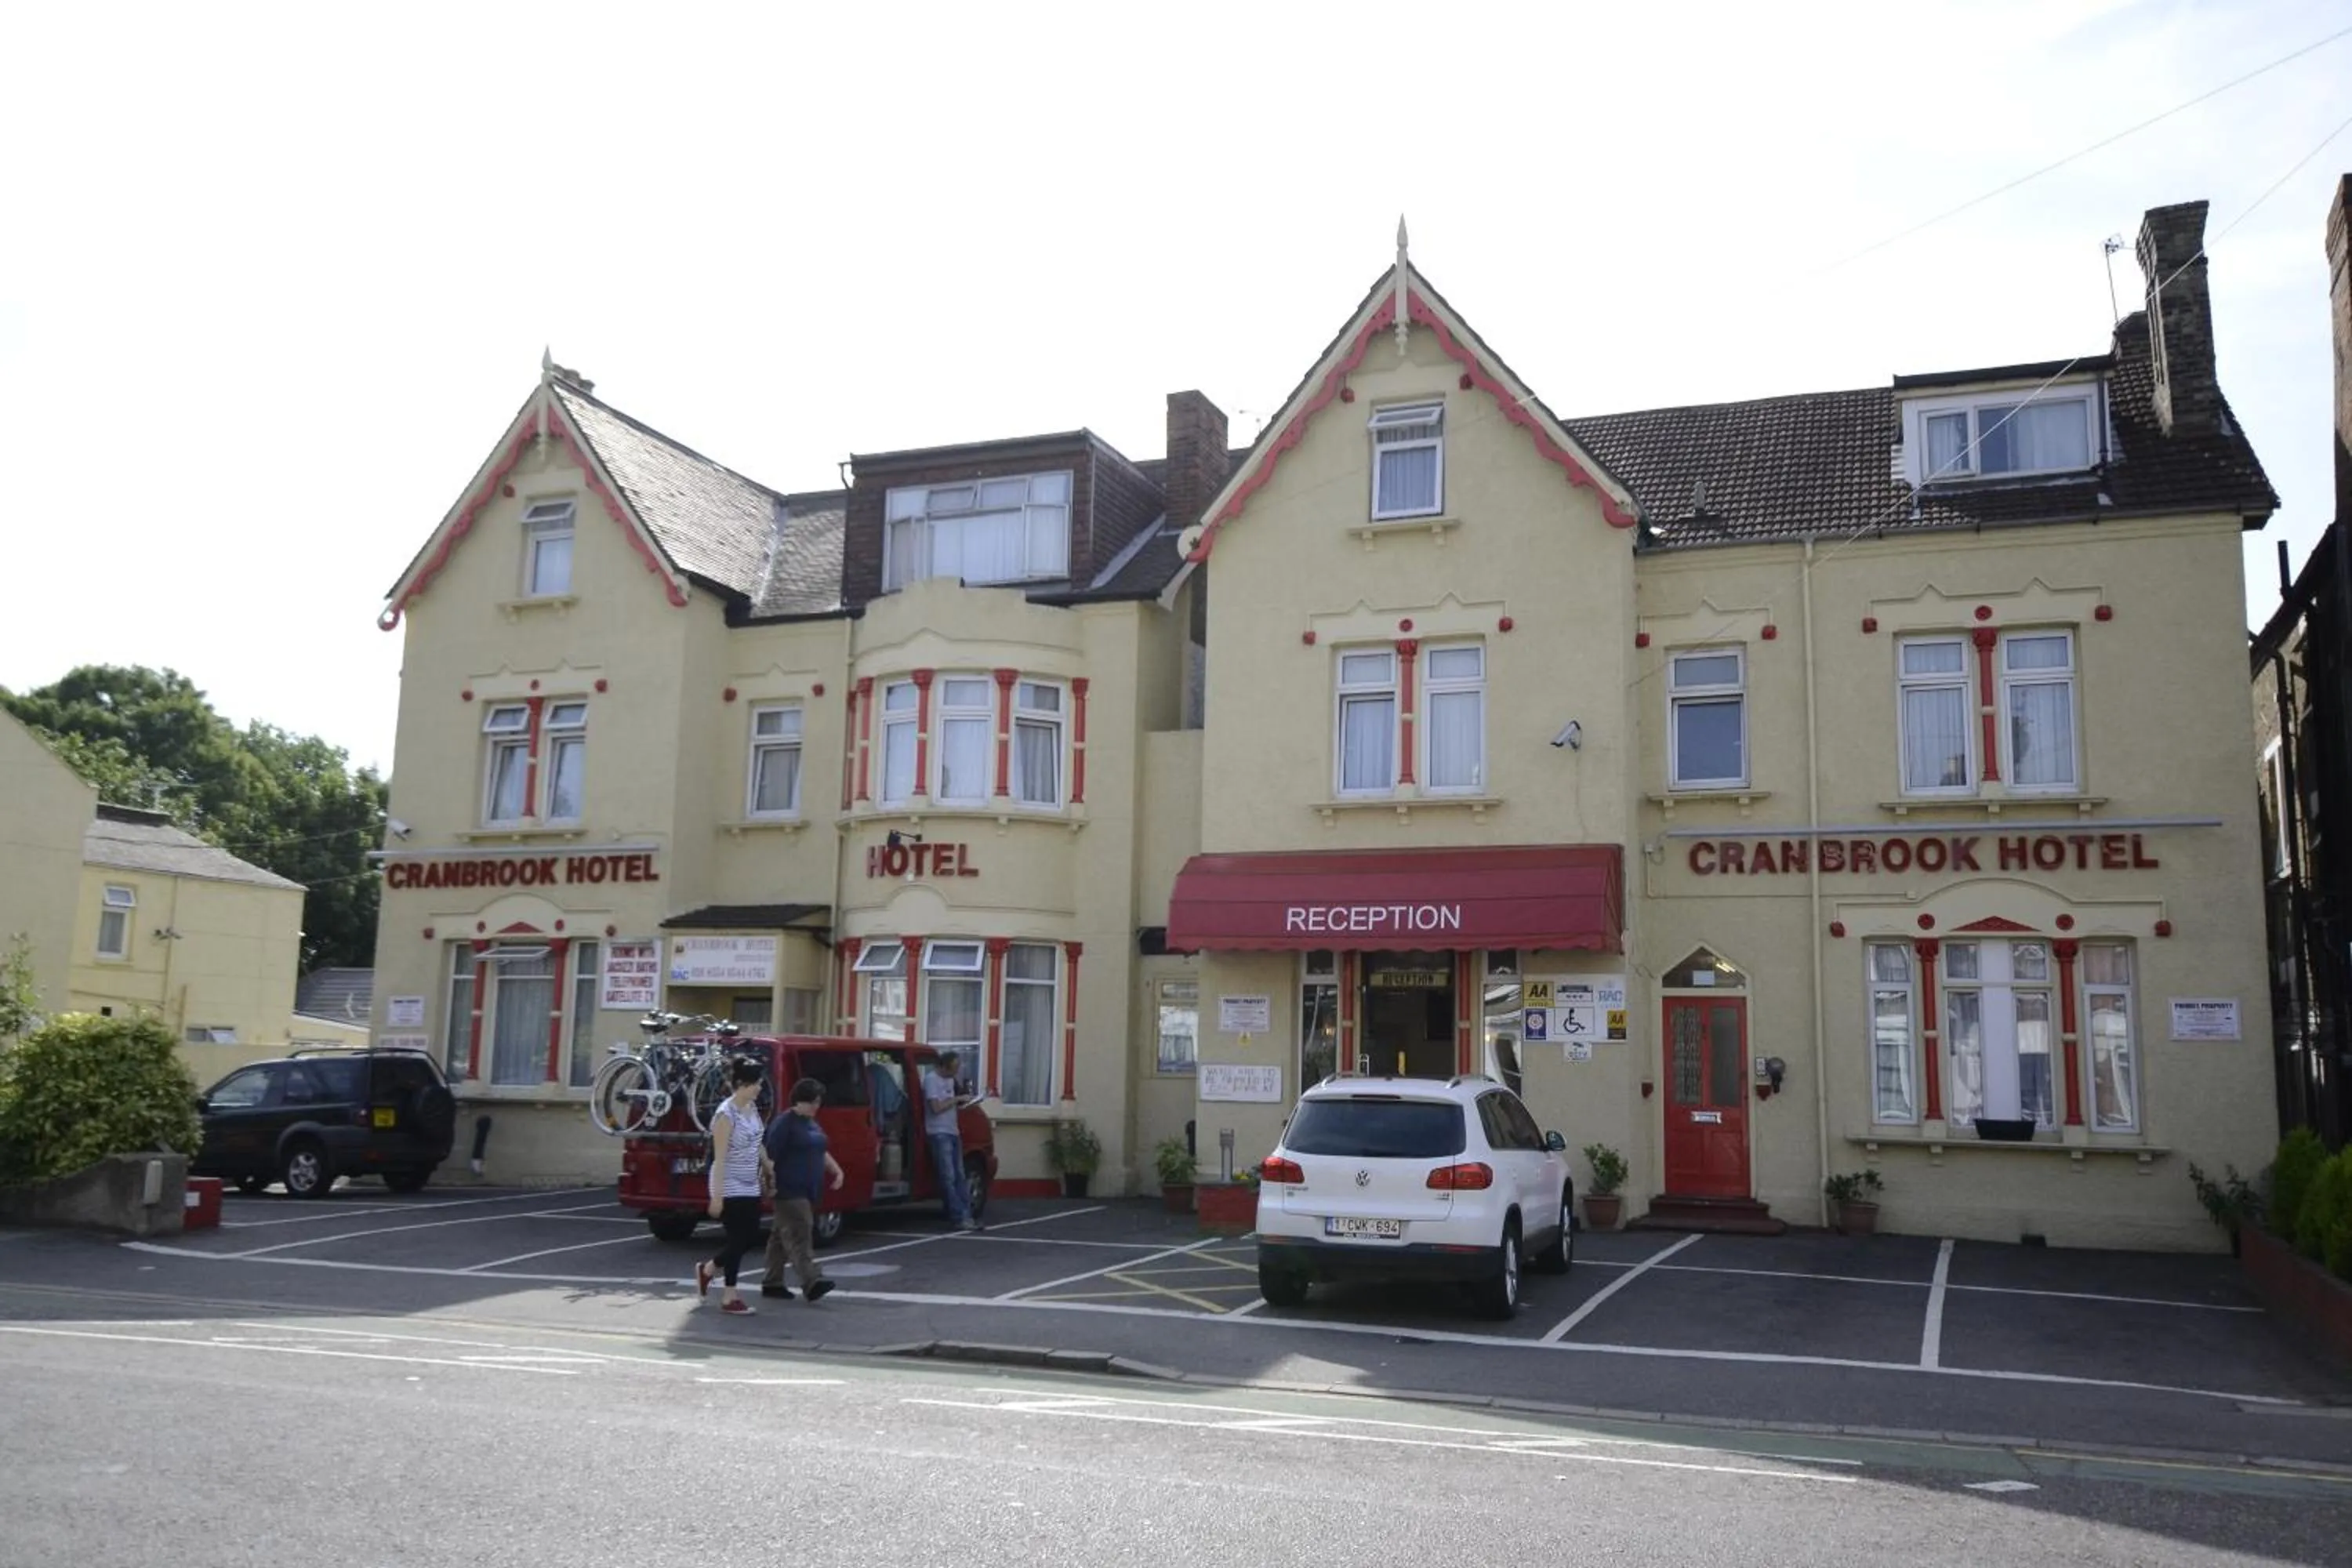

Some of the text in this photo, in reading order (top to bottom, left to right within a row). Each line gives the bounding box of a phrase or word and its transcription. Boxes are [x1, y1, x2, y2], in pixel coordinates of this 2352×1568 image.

[387, 854, 660, 890] CRANBROOK HOTEL
[866, 843, 980, 878] HOTEL
[1688, 833, 2160, 876] CRANBROOK HOTEL
[1286, 904, 1461, 931] RECEPTION
[1529, 984, 1548, 998] AA
